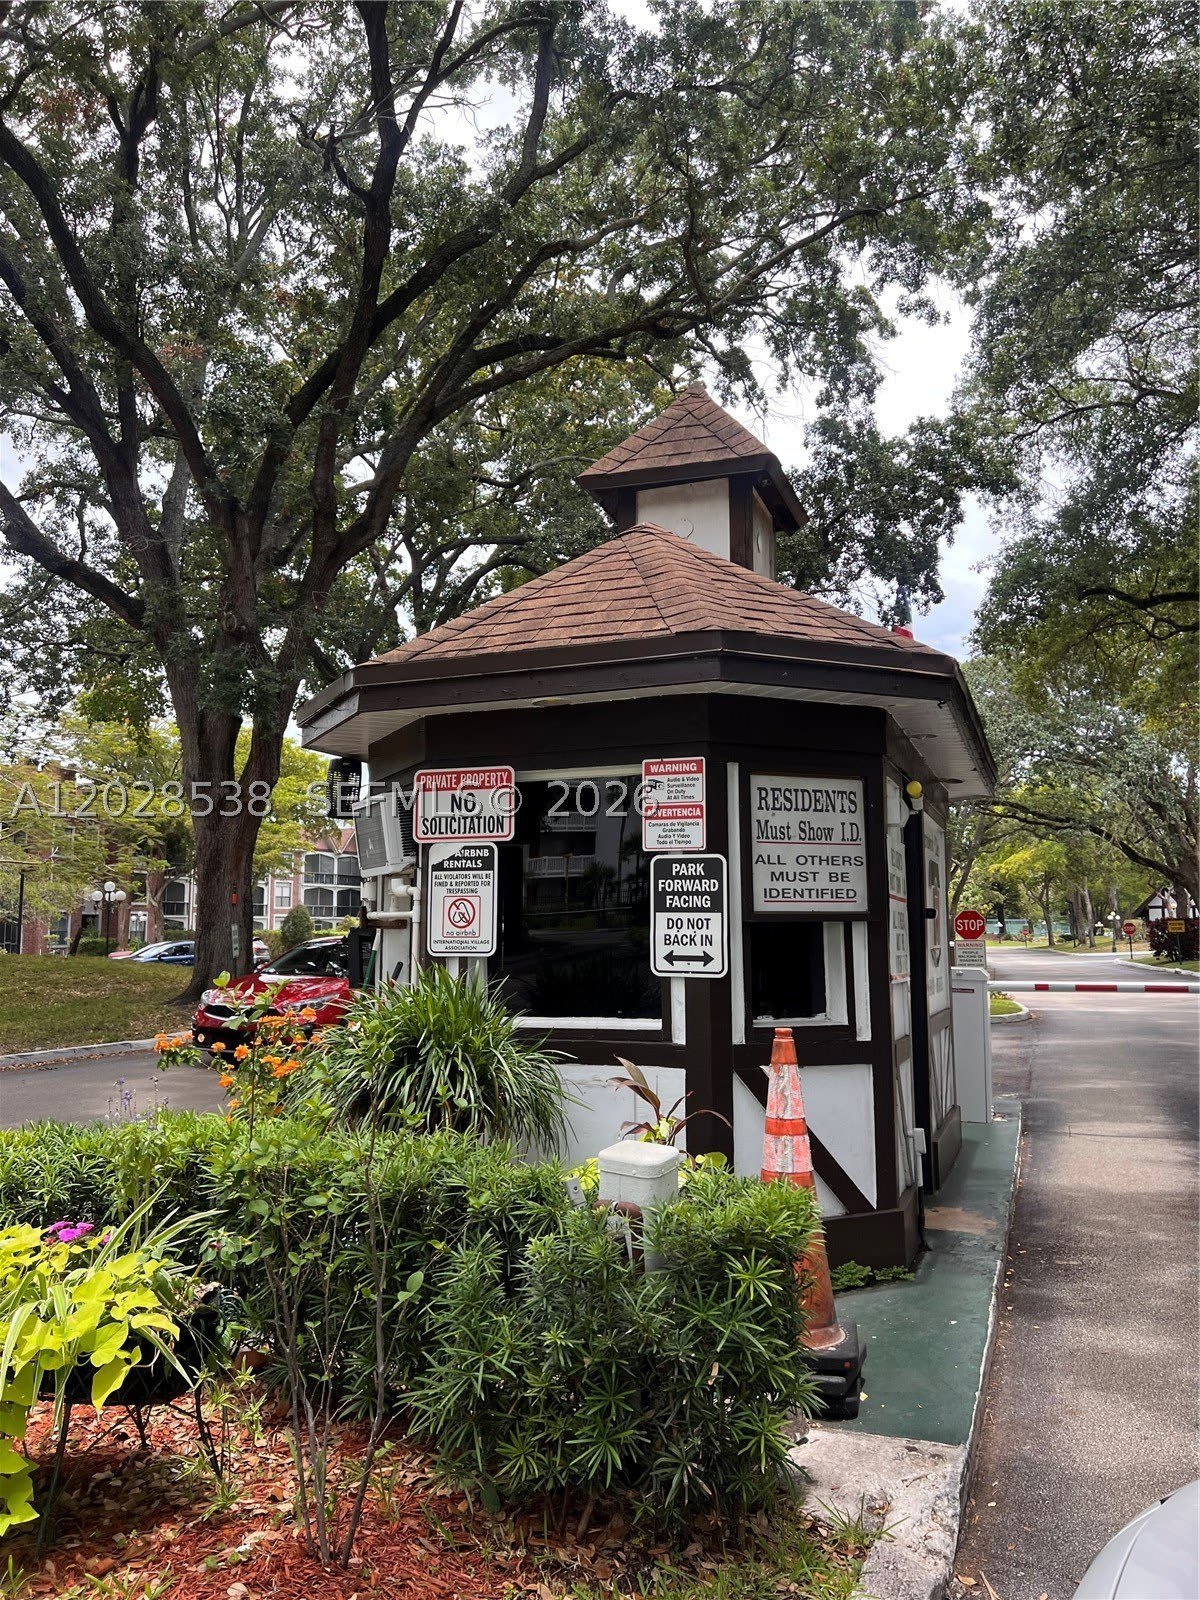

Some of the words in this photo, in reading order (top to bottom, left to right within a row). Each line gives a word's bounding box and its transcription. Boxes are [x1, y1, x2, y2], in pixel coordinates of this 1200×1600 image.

[650, 762, 697, 773] WARNING
[420, 774, 458, 789] PRIVATE
[460, 772, 509, 788] PROPERTY
[451, 792, 477, 813] NO
[756, 786, 858, 814] RESIDENTS
[647, 806, 702, 818] AVERTENCIA
[422, 816, 505, 836] SOLICITATION
[756, 819, 791, 841] Must
[798, 820, 834, 841] Show
[840, 822, 862, 842] I.D.
[444, 860, 482, 868] RENTALS
[754, 854, 787, 865] ALL
[796, 855, 864, 866] OTHERS
[672, 863, 705, 876] PARK
[770, 871, 819, 883] MUST
[829, 872, 850, 882] BE
[658, 879, 719, 892] FORWARD
[764, 888, 857, 899] IDENTIFIED
[666, 895, 711, 908] FACING
[667, 918, 683, 930] DO
[687, 918, 711, 930] NOT
[956, 920, 984, 931] STOP
[664, 934, 697, 946] BACK
[700, 935, 713, 946] IN
